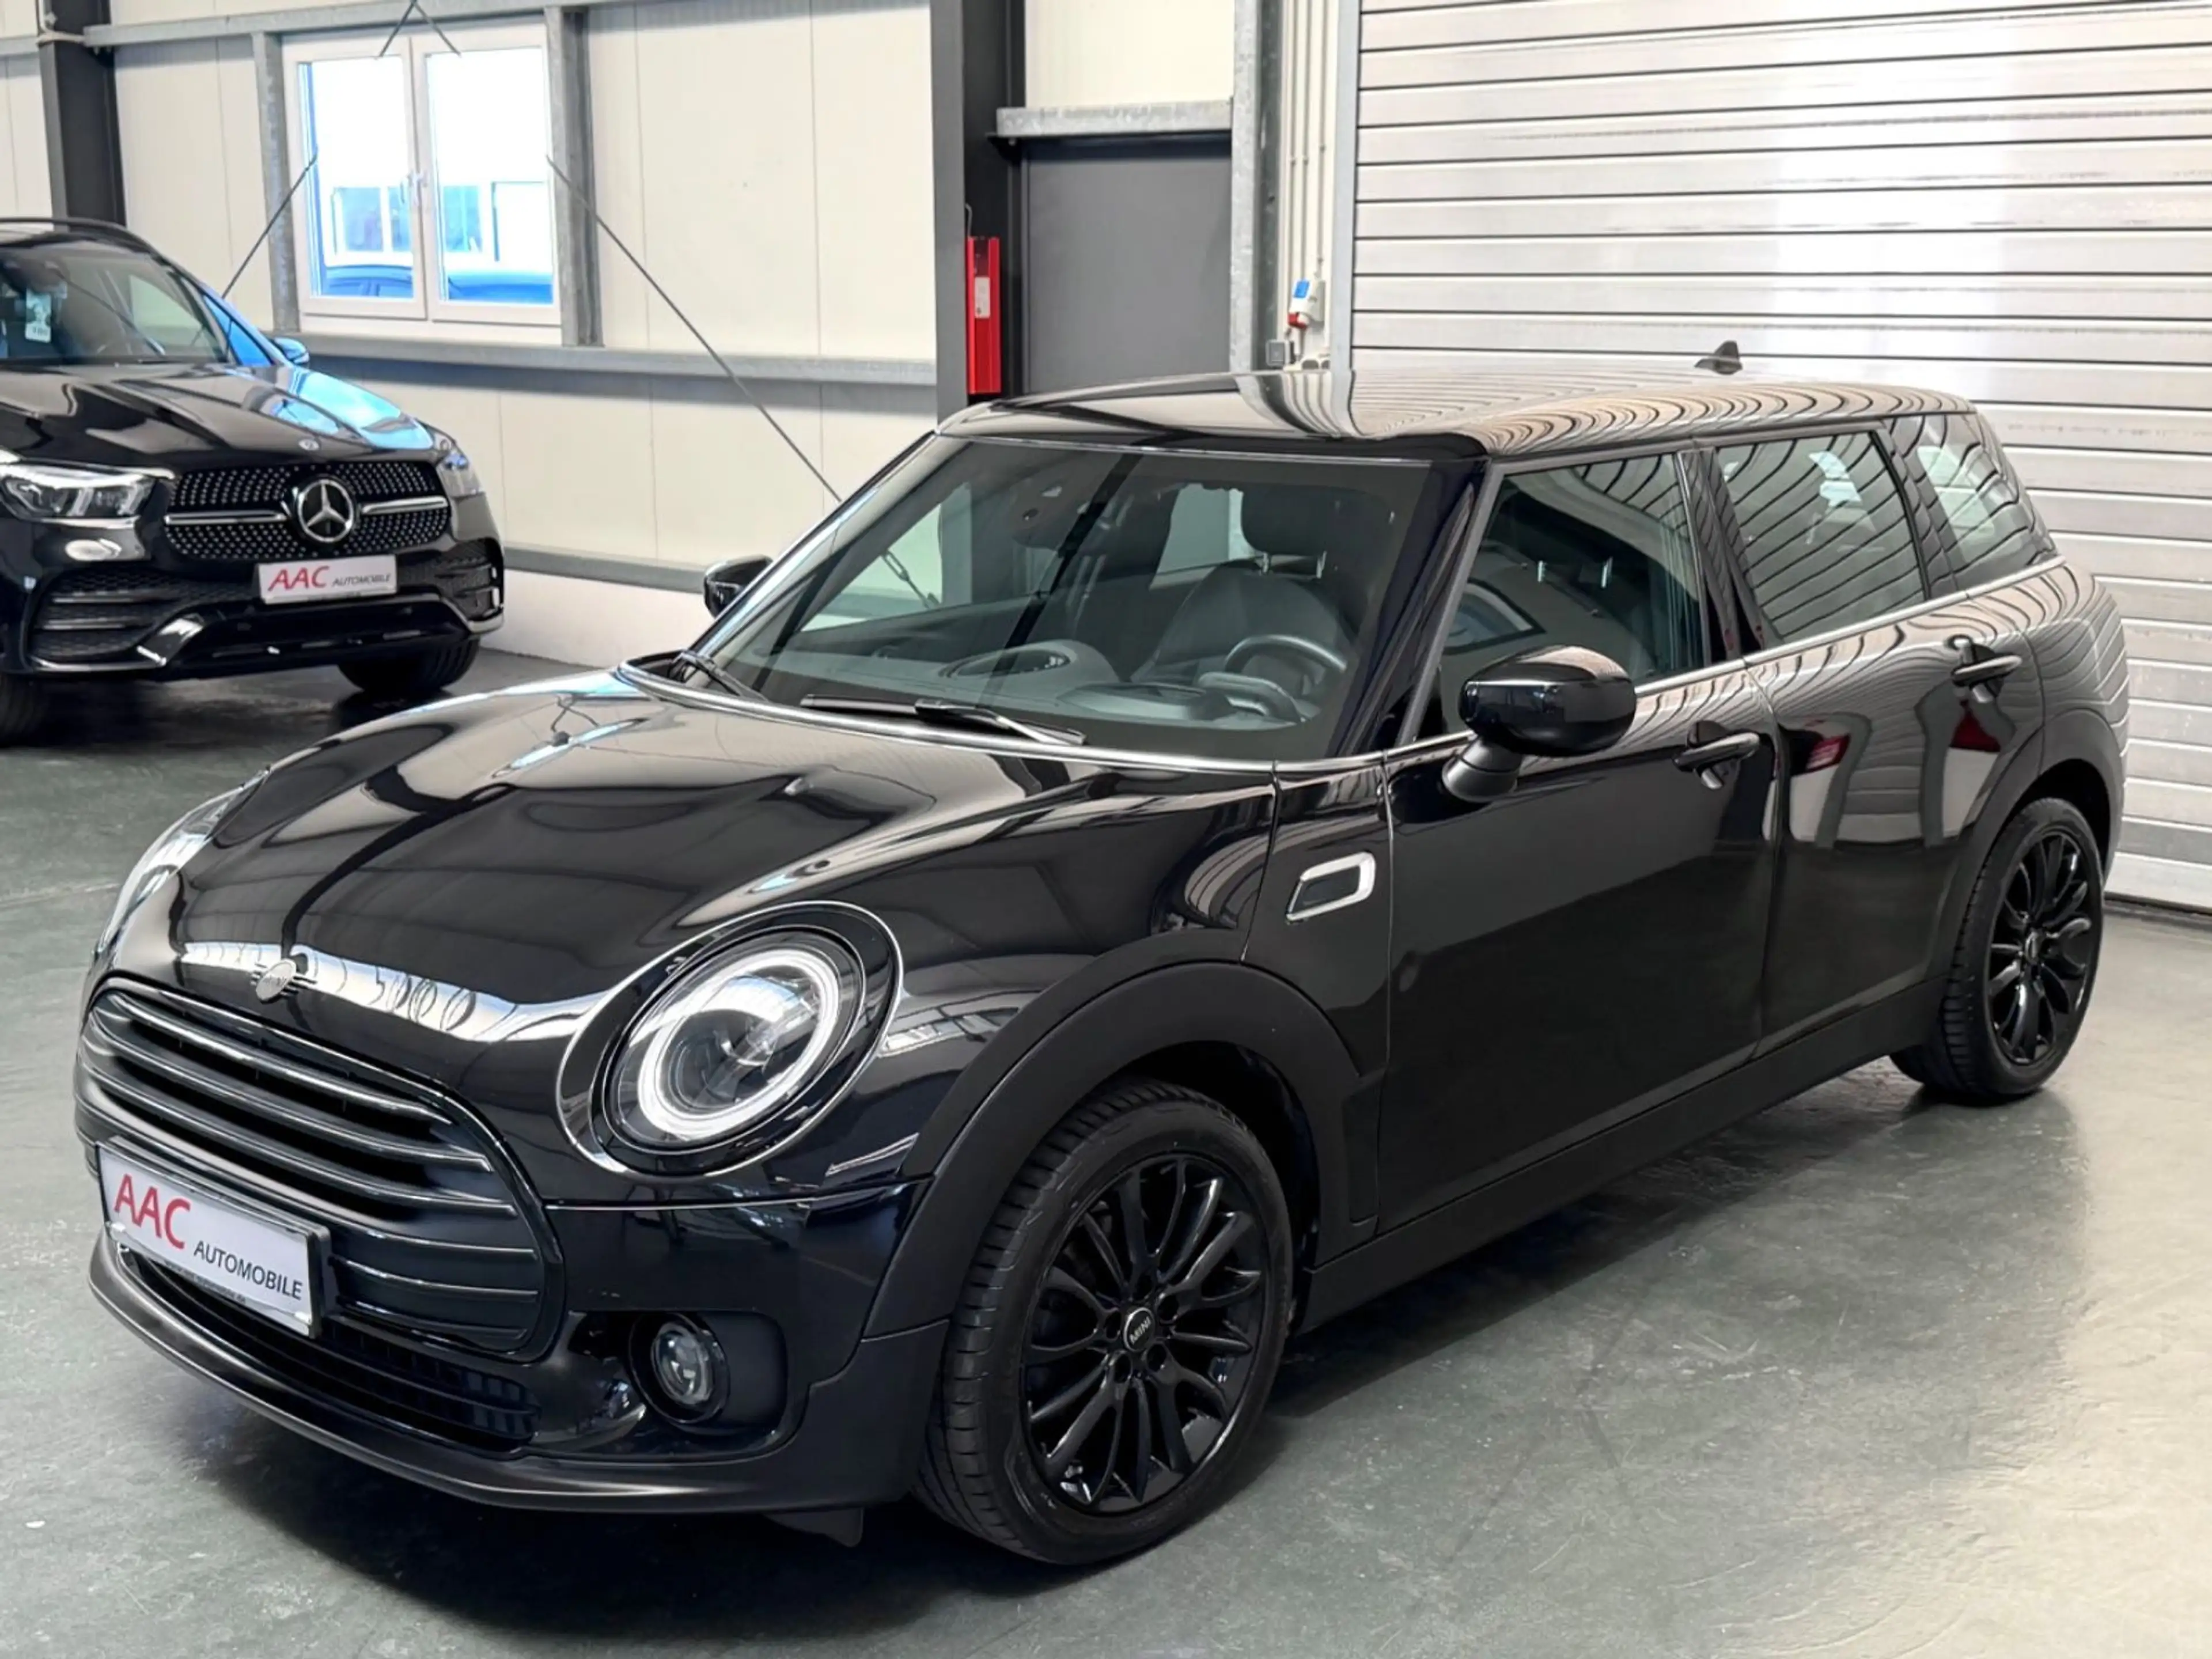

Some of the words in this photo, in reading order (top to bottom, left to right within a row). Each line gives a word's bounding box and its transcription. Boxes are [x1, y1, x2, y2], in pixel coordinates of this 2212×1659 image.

[268, 566, 329, 592] AAC
[332, 574, 391, 586] AUTOMOBILE
[114, 1173, 191, 1249] AAC
[194, 1241, 303, 1300] AUTOMOBILE
[1130, 1316, 1151, 1344] MINI
